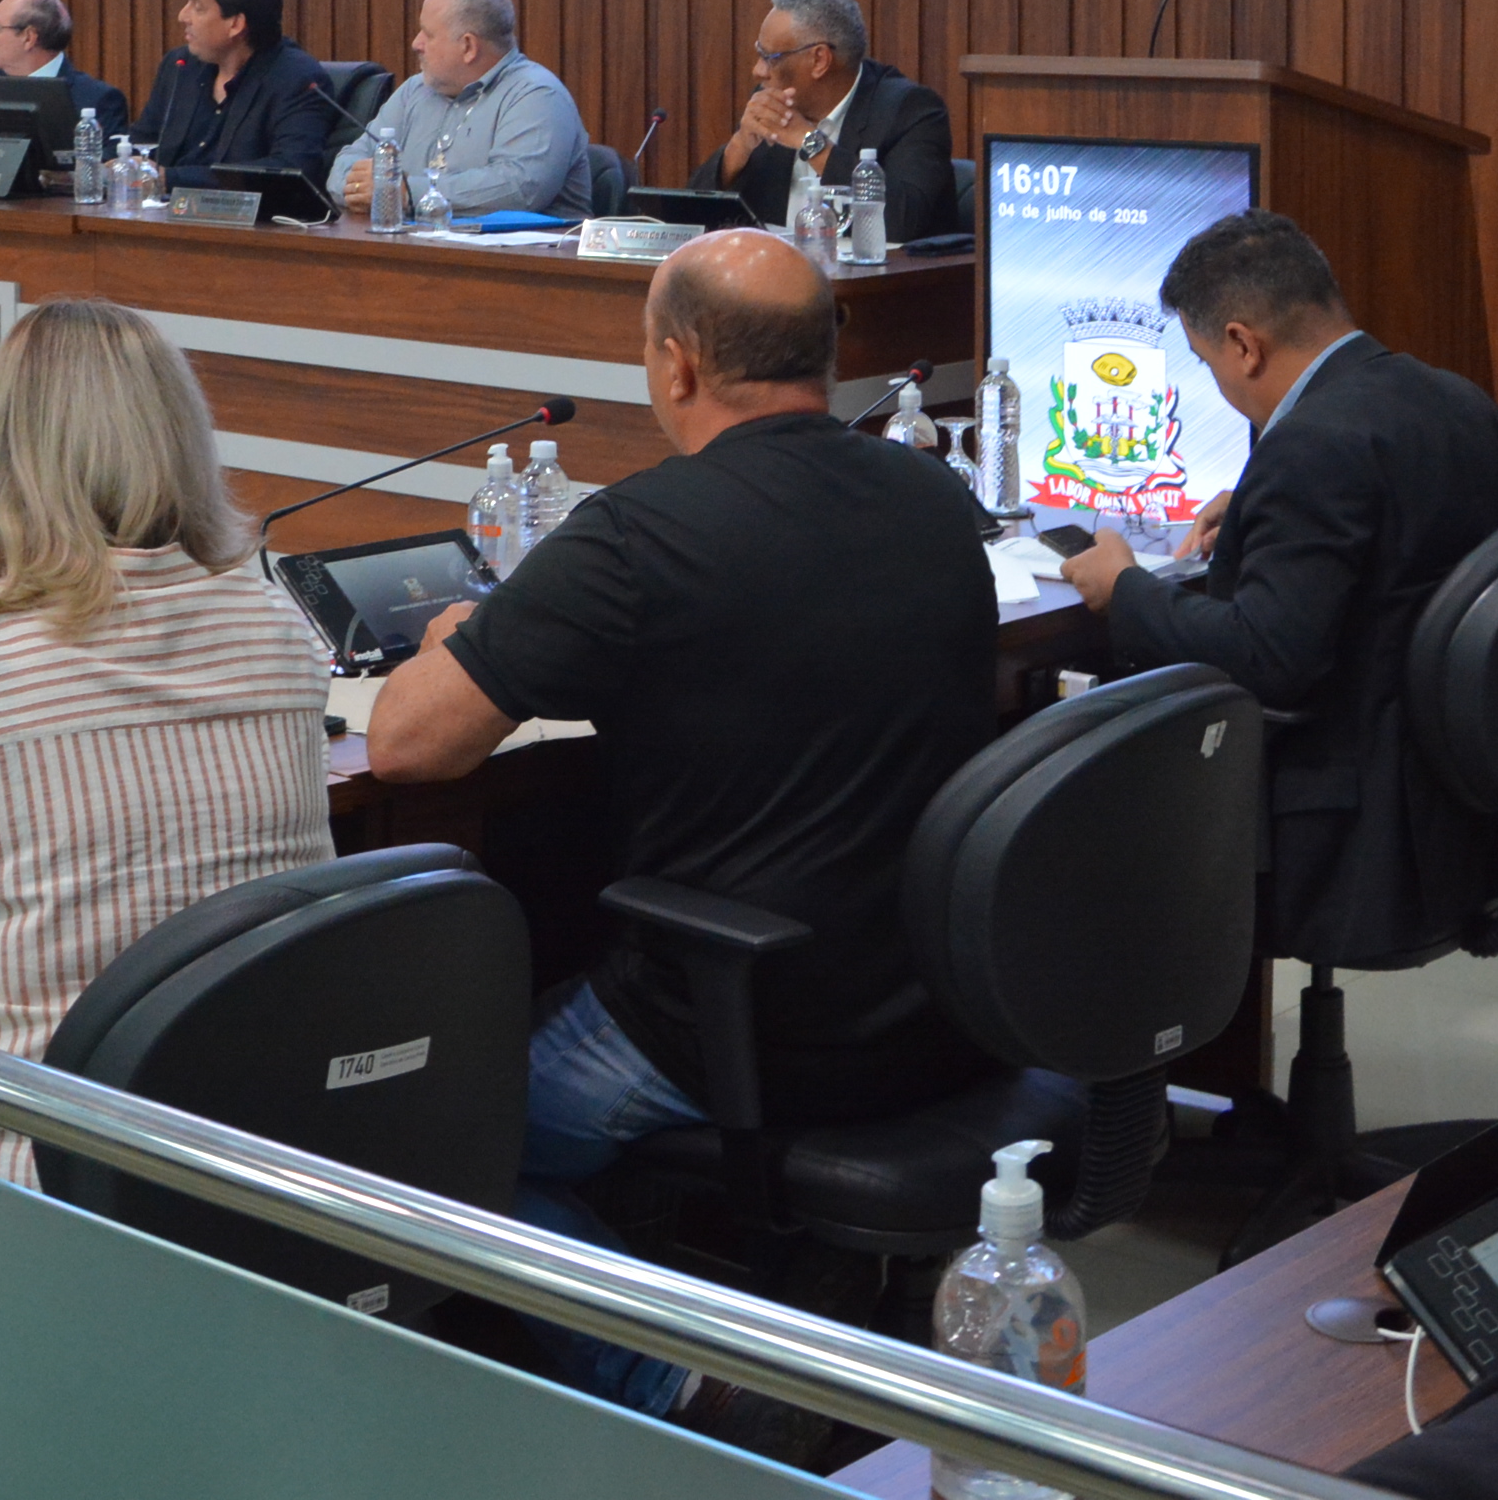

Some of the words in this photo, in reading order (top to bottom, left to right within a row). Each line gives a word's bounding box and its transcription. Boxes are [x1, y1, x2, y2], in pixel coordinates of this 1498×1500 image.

[996, 162, 1079, 196] 16:07
[998, 202, 1016, 218] 04
[1021, 203, 1040, 219] de
[1045, 204, 1082, 223] julho
[1088, 207, 1107, 223] de
[1113, 208, 1148, 225] 2025
[1048, 477, 1093, 504] LABOR
[1137, 489, 1183, 509] VINCIT
[339, 1054, 375, 1079] 1740
